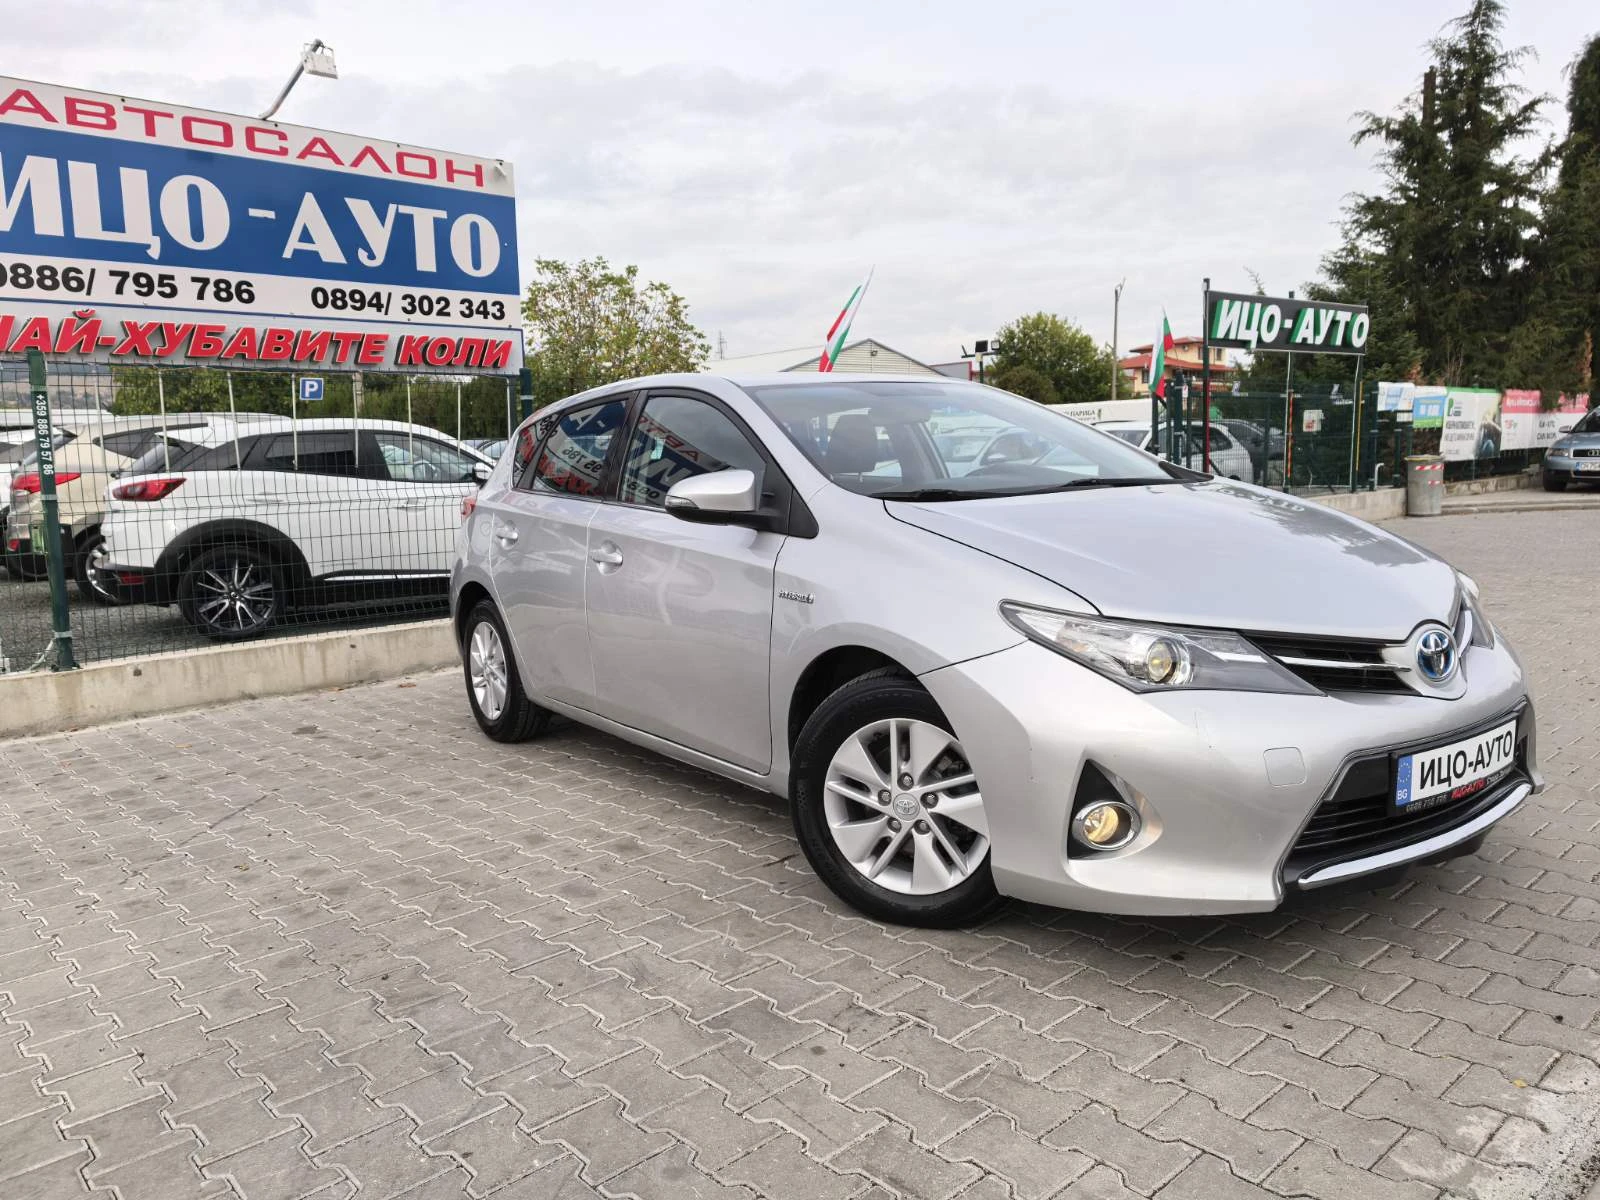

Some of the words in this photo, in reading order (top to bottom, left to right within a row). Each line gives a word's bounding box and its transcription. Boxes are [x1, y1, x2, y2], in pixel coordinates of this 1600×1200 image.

[0, 88, 484, 188] АВТОСАЛОН
[109, 270, 178, 299] 795
[191, 276, 255, 304] 786
[311, 286, 392, 316] 0894/
[401, 294, 451, 317] 302
[459, 298, 506, 321] 343
[1214, 299, 1370, 349] ИЦО-АУТО
[399, 334, 513, 369] КОЛИ
[304, 380, 319, 398] P
[36, 394, 47, 416] +359
[37, 419, 49, 435] 886
[40, 438, 50, 448] 79
[41, 451, 53, 462] 57
[42, 464, 54, 475] 86
[1419, 730, 1513, 790] ИЦО-АУТО
[1397, 788, 1409, 801] BG
